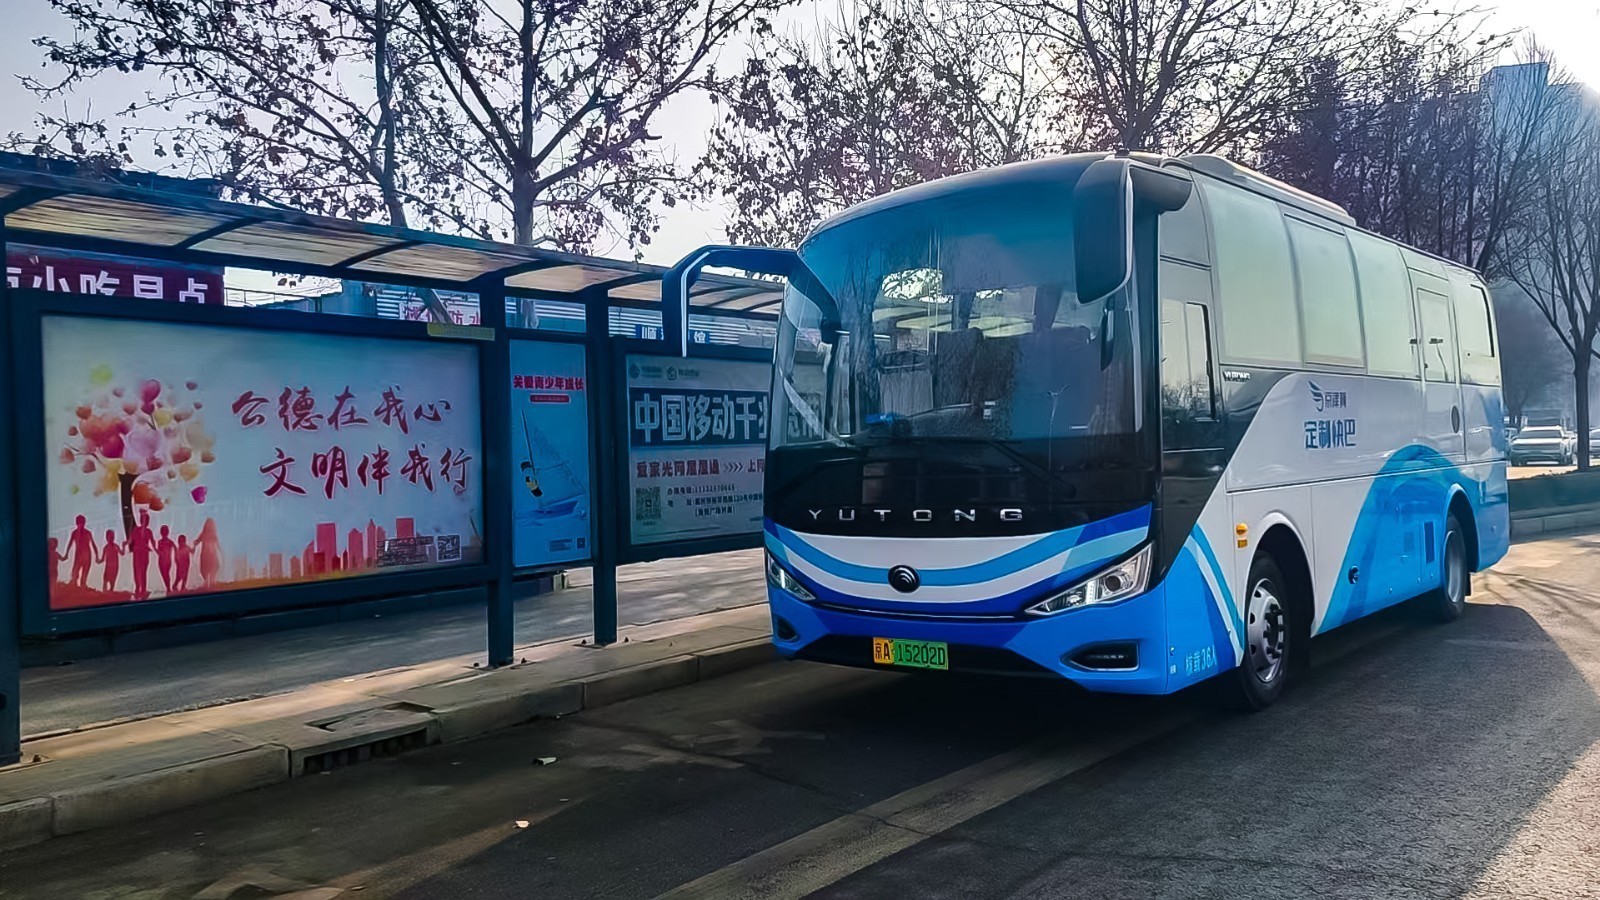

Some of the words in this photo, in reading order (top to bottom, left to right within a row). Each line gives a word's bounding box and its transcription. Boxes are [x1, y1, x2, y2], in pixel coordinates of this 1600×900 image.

[231, 384, 452, 434] 公德在我心
[1304, 419, 1356, 449] 定制快巴
[259, 443, 472, 499] 文明伴我行
[808, 508, 1023, 522] YUTONG
